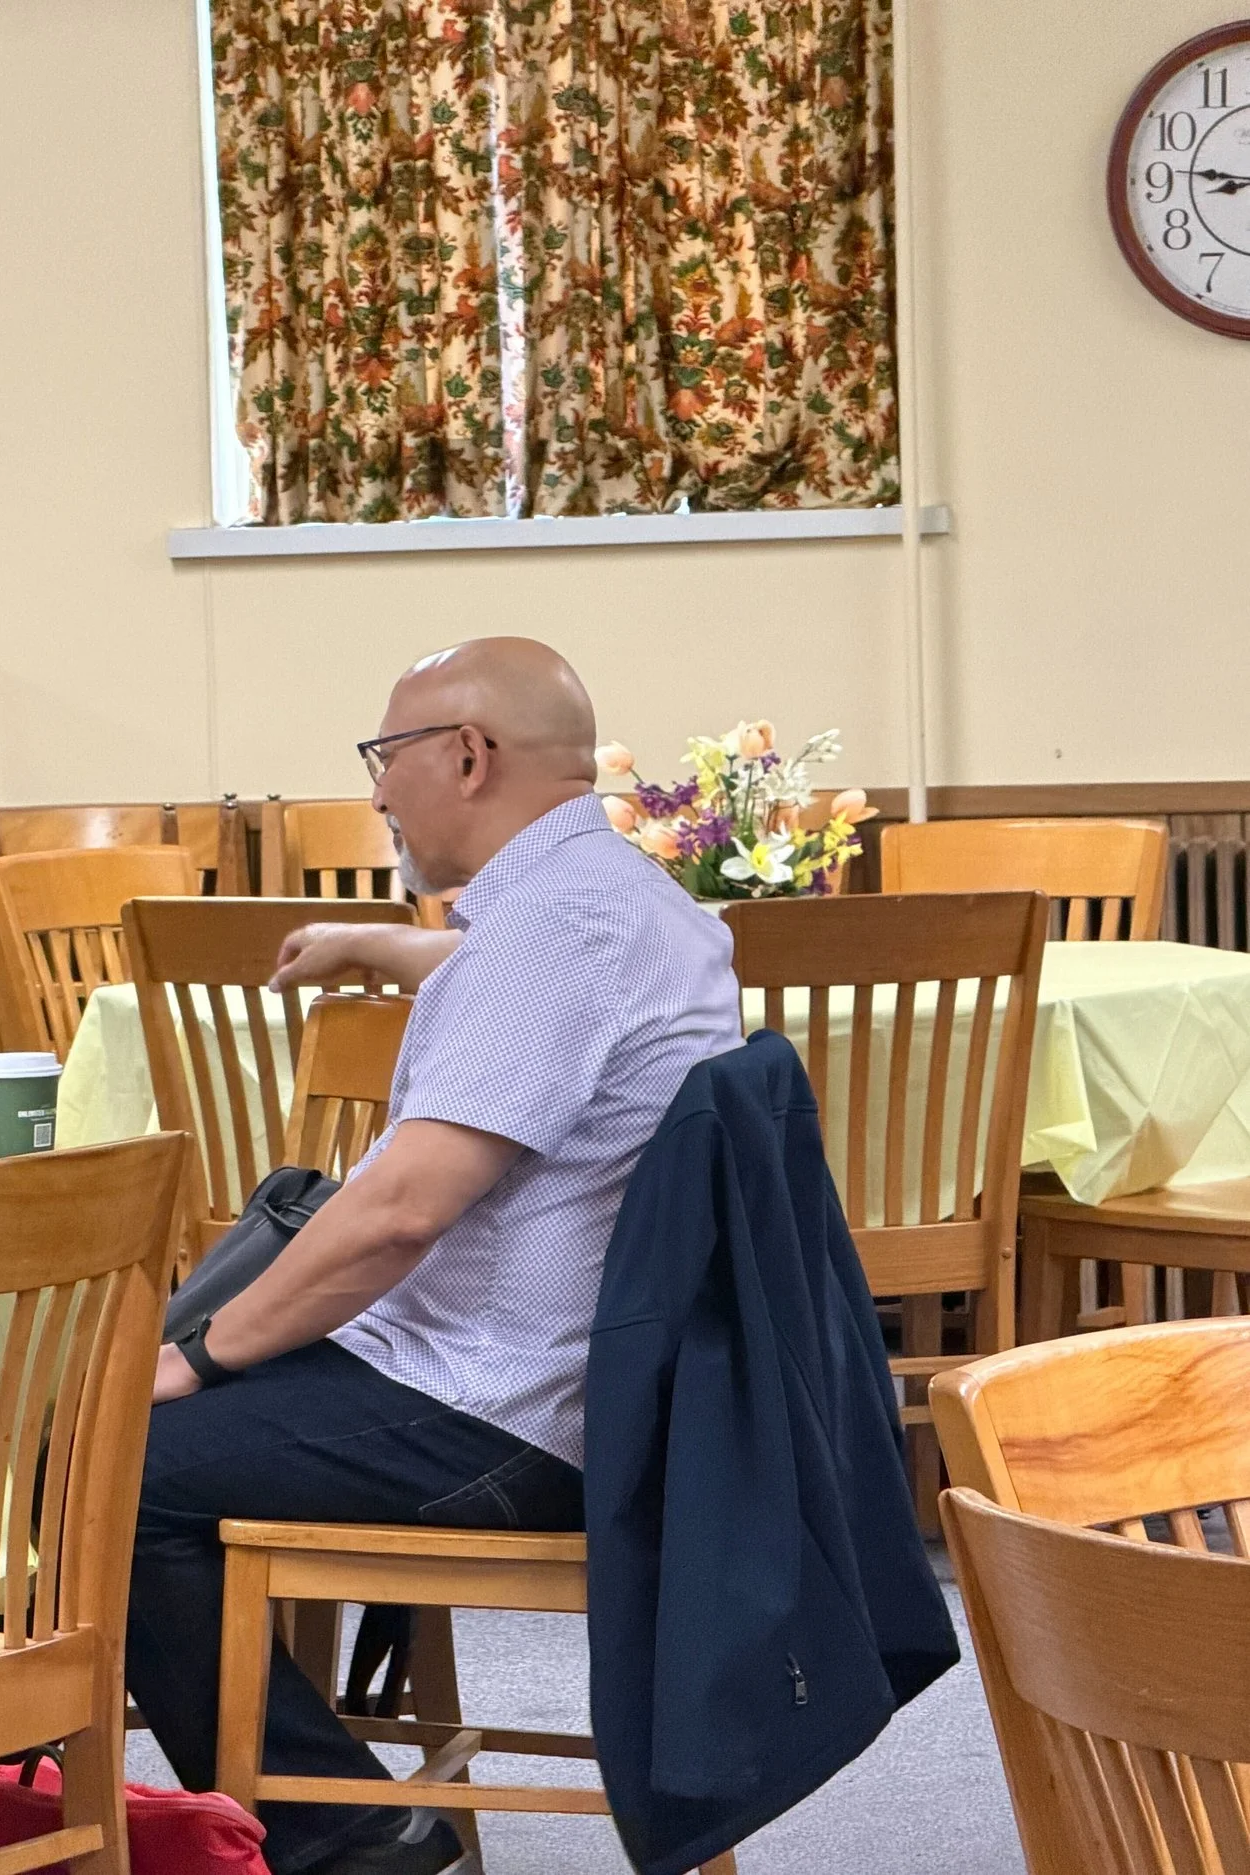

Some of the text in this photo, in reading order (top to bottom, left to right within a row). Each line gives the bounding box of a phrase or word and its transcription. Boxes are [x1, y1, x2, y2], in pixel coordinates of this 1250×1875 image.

[1199, 67, 1234, 109] 11
[1154, 111, 1197, 152] 10
[1145, 161, 1174, 203] 9
[1162, 208, 1192, 250] 8
[1199, 252, 1225, 293] 7
